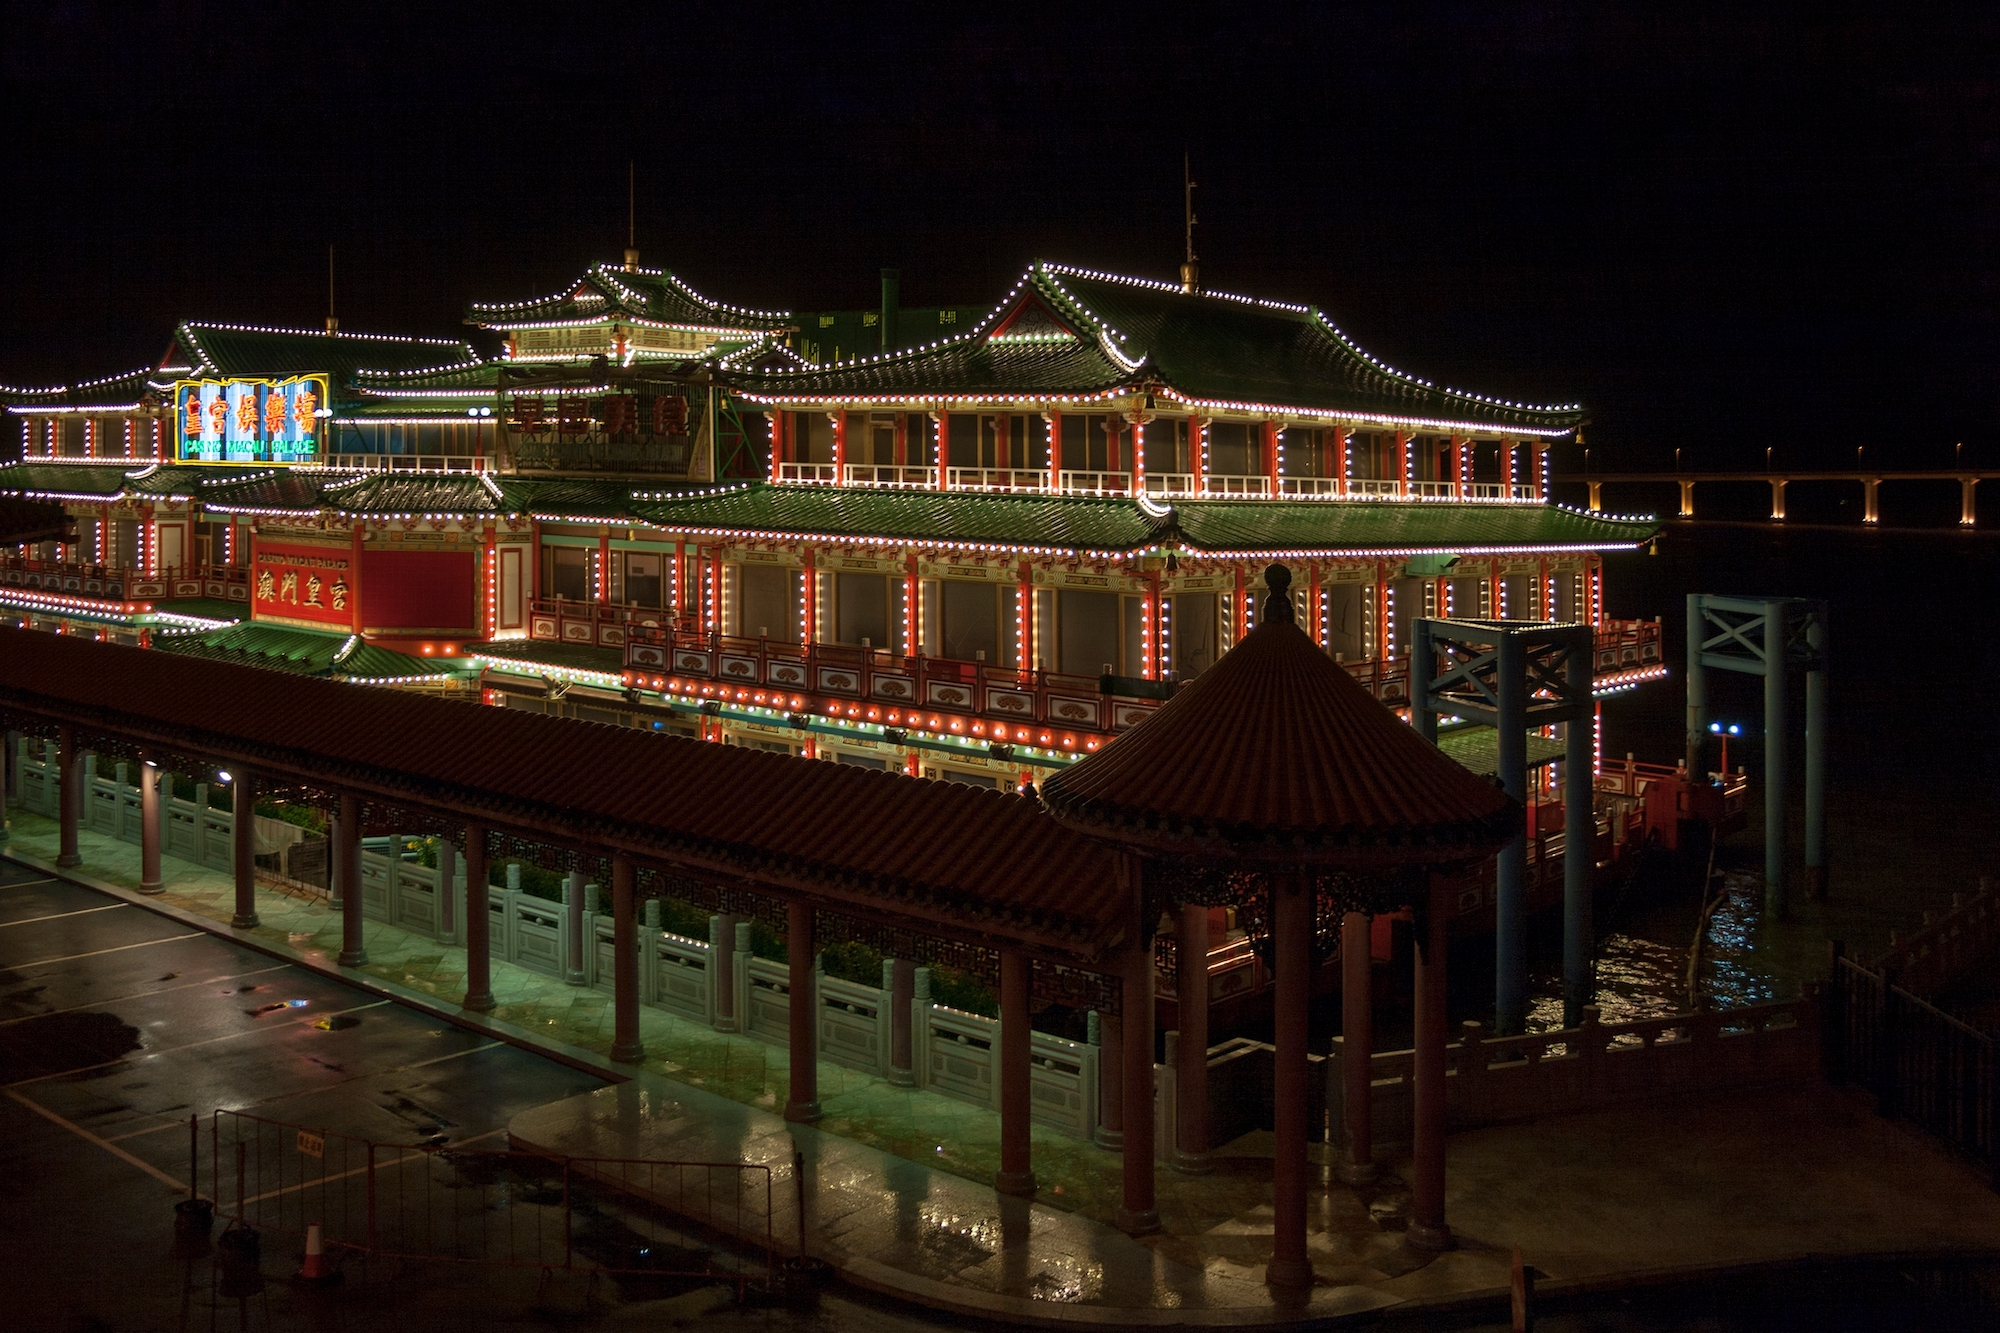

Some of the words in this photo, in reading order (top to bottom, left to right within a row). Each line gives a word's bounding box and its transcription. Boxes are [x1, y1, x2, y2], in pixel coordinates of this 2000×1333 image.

[184, 391, 317, 435] 皇宮娛樂場
[184, 439, 221, 454] CASINO
[227, 439, 265, 454] MACAU
[271, 439, 315, 454] PALACE
[258, 552, 286, 565] CASINO
[287, 554, 316, 568] MACAU
[317, 557, 348, 571] PALACE
[257, 567, 349, 611] 澳門皇宮
